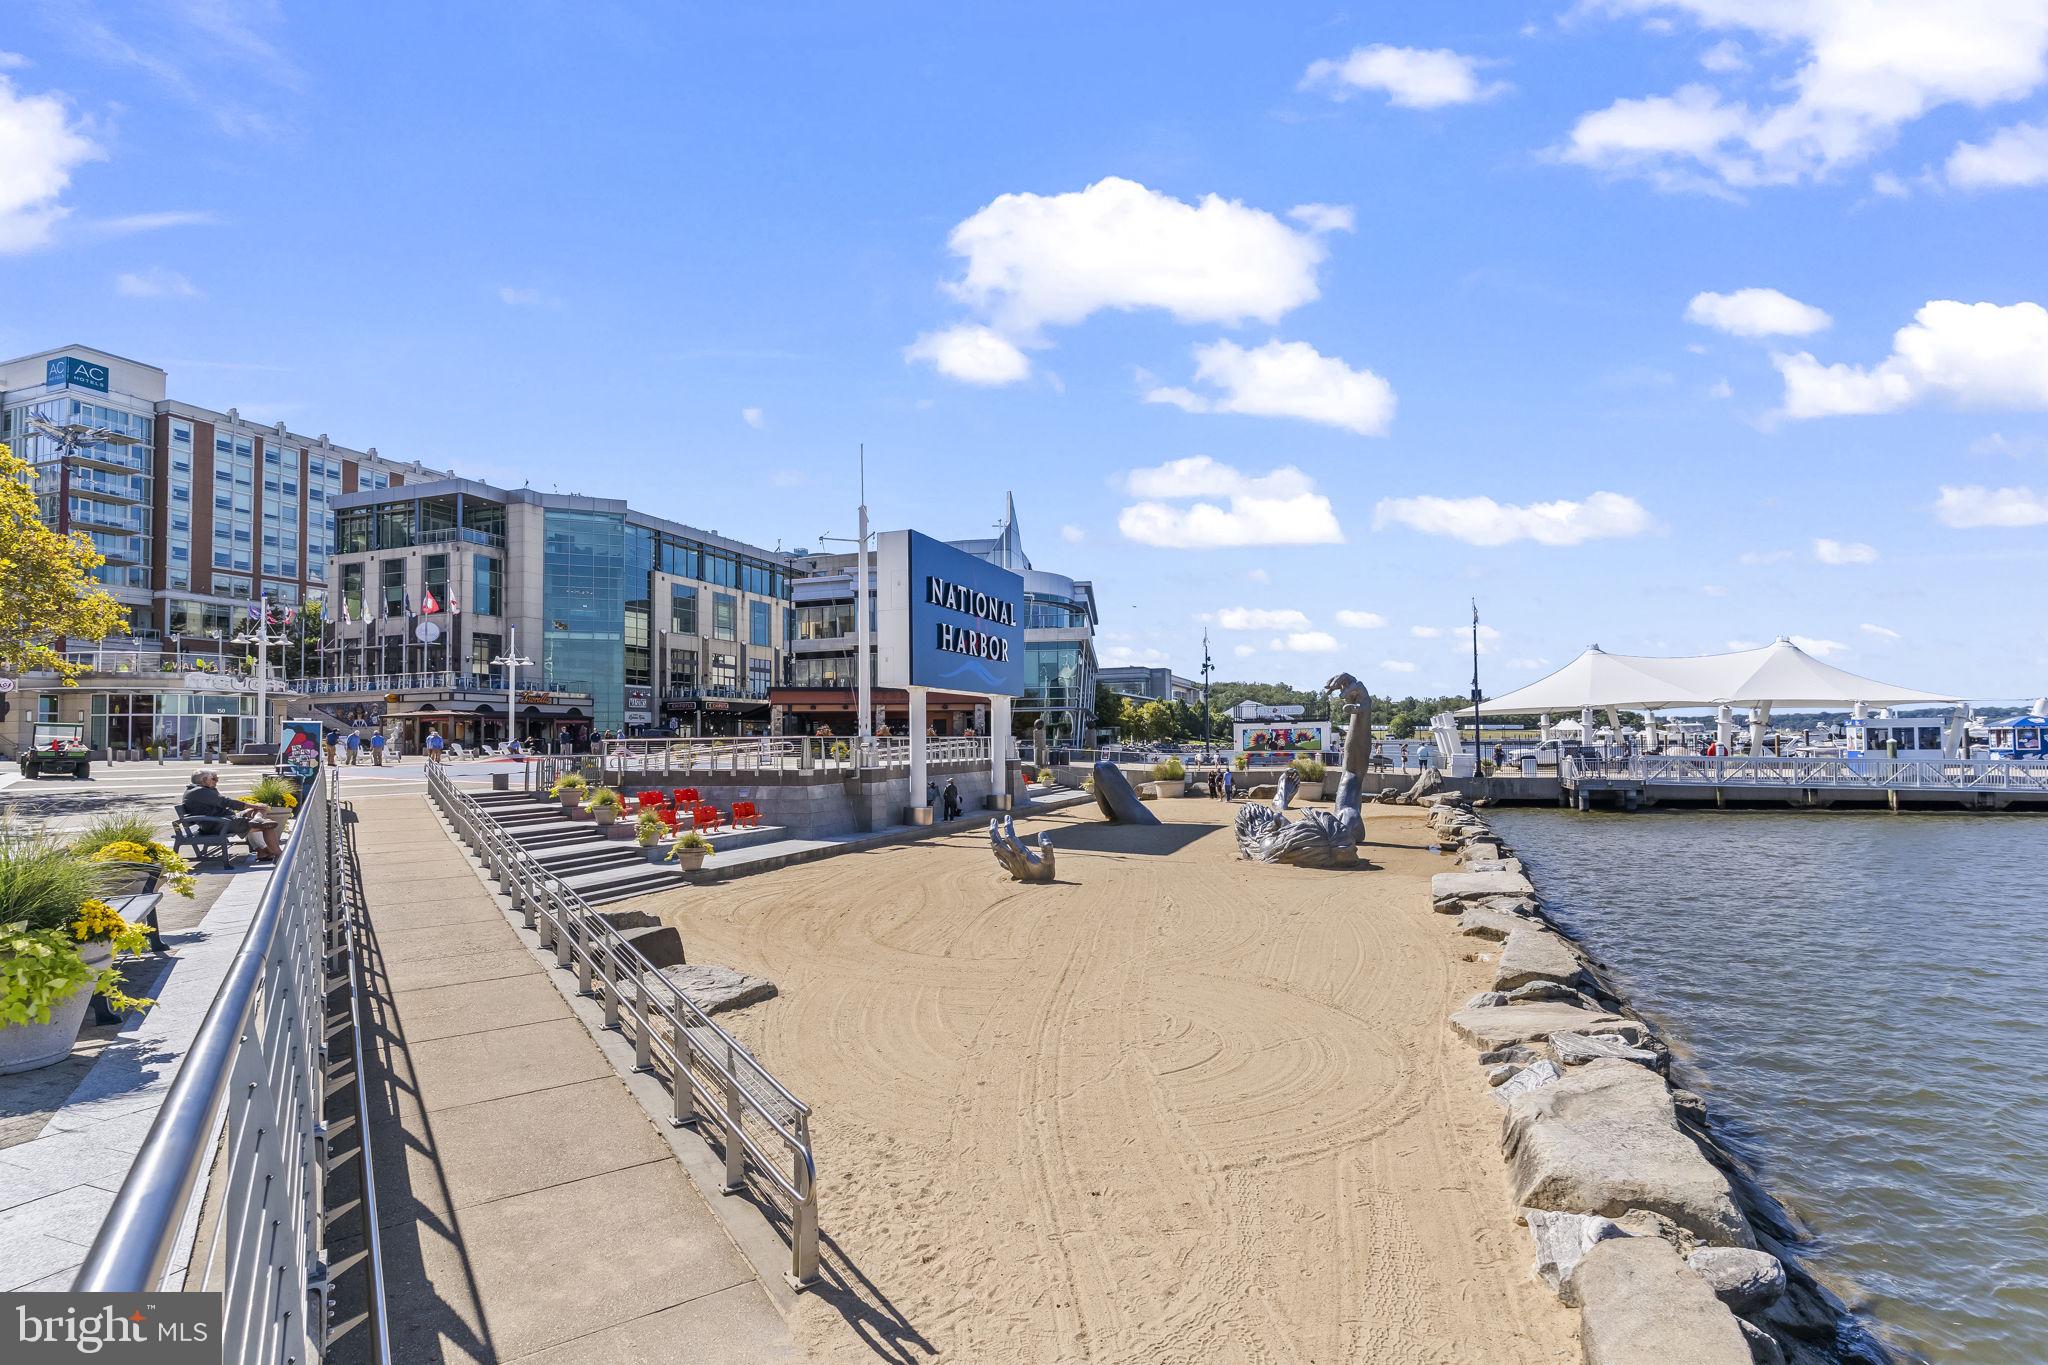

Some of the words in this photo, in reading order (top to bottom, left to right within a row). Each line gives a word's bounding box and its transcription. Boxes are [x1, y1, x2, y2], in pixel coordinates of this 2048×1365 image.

[50, 361, 65, 375] AC
[74, 364, 104, 381] AC
[73, 375, 104, 387] HOTELS
[929, 576, 1017, 627] NATIONAL
[939, 623, 1009, 662] HARBOR
